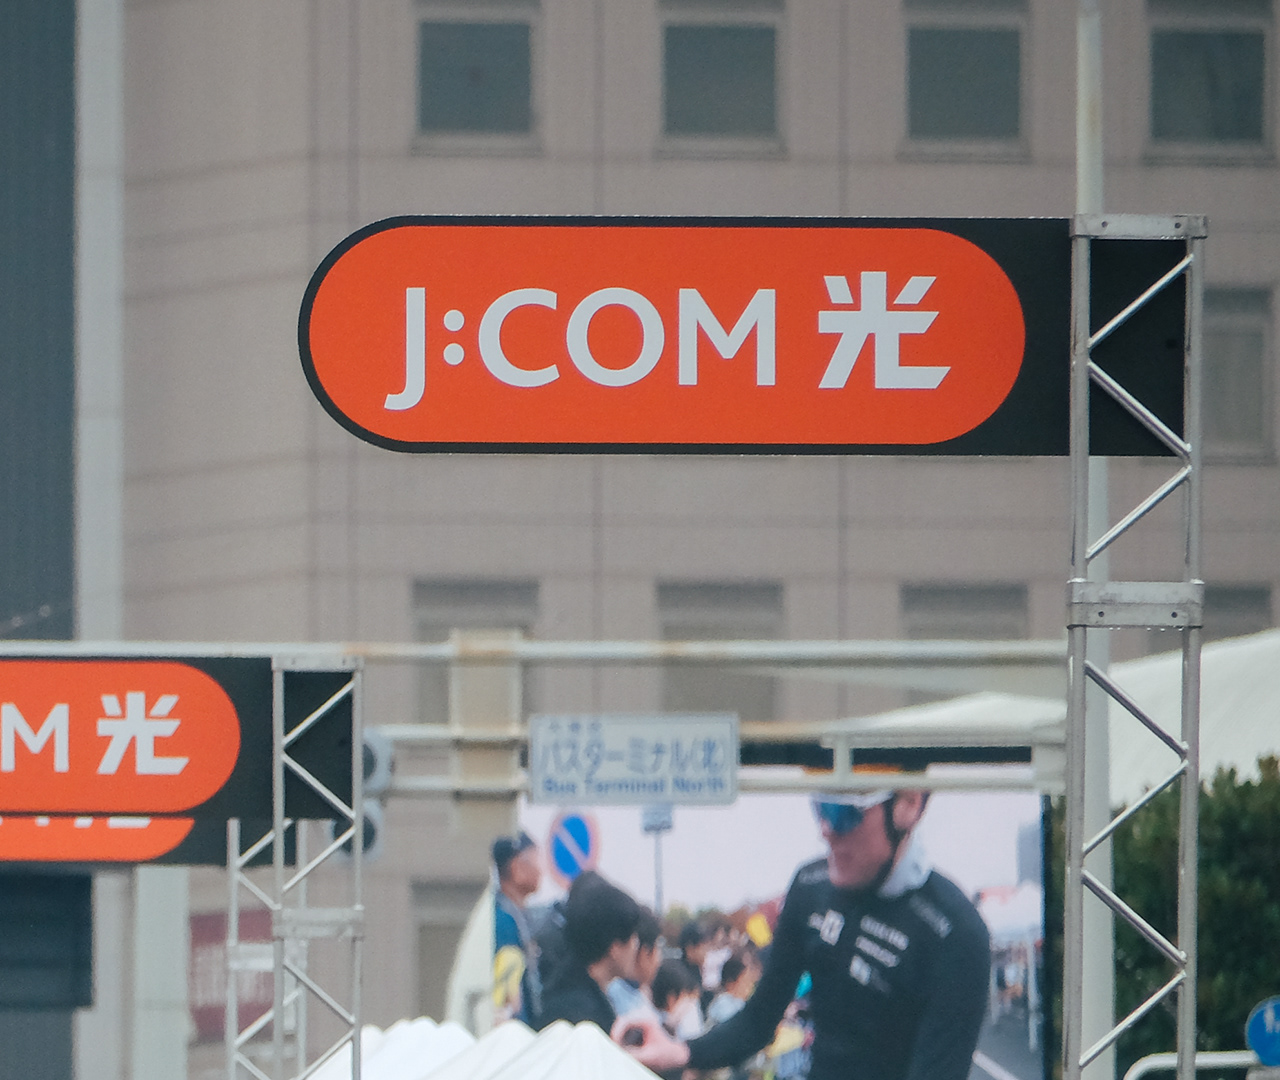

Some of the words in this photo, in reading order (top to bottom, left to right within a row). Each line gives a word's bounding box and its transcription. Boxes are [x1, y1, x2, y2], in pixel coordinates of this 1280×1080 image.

[384, 287, 776, 410] J:COM
[817, 271, 952, 389] 光
[96, 691, 190, 776] 光
